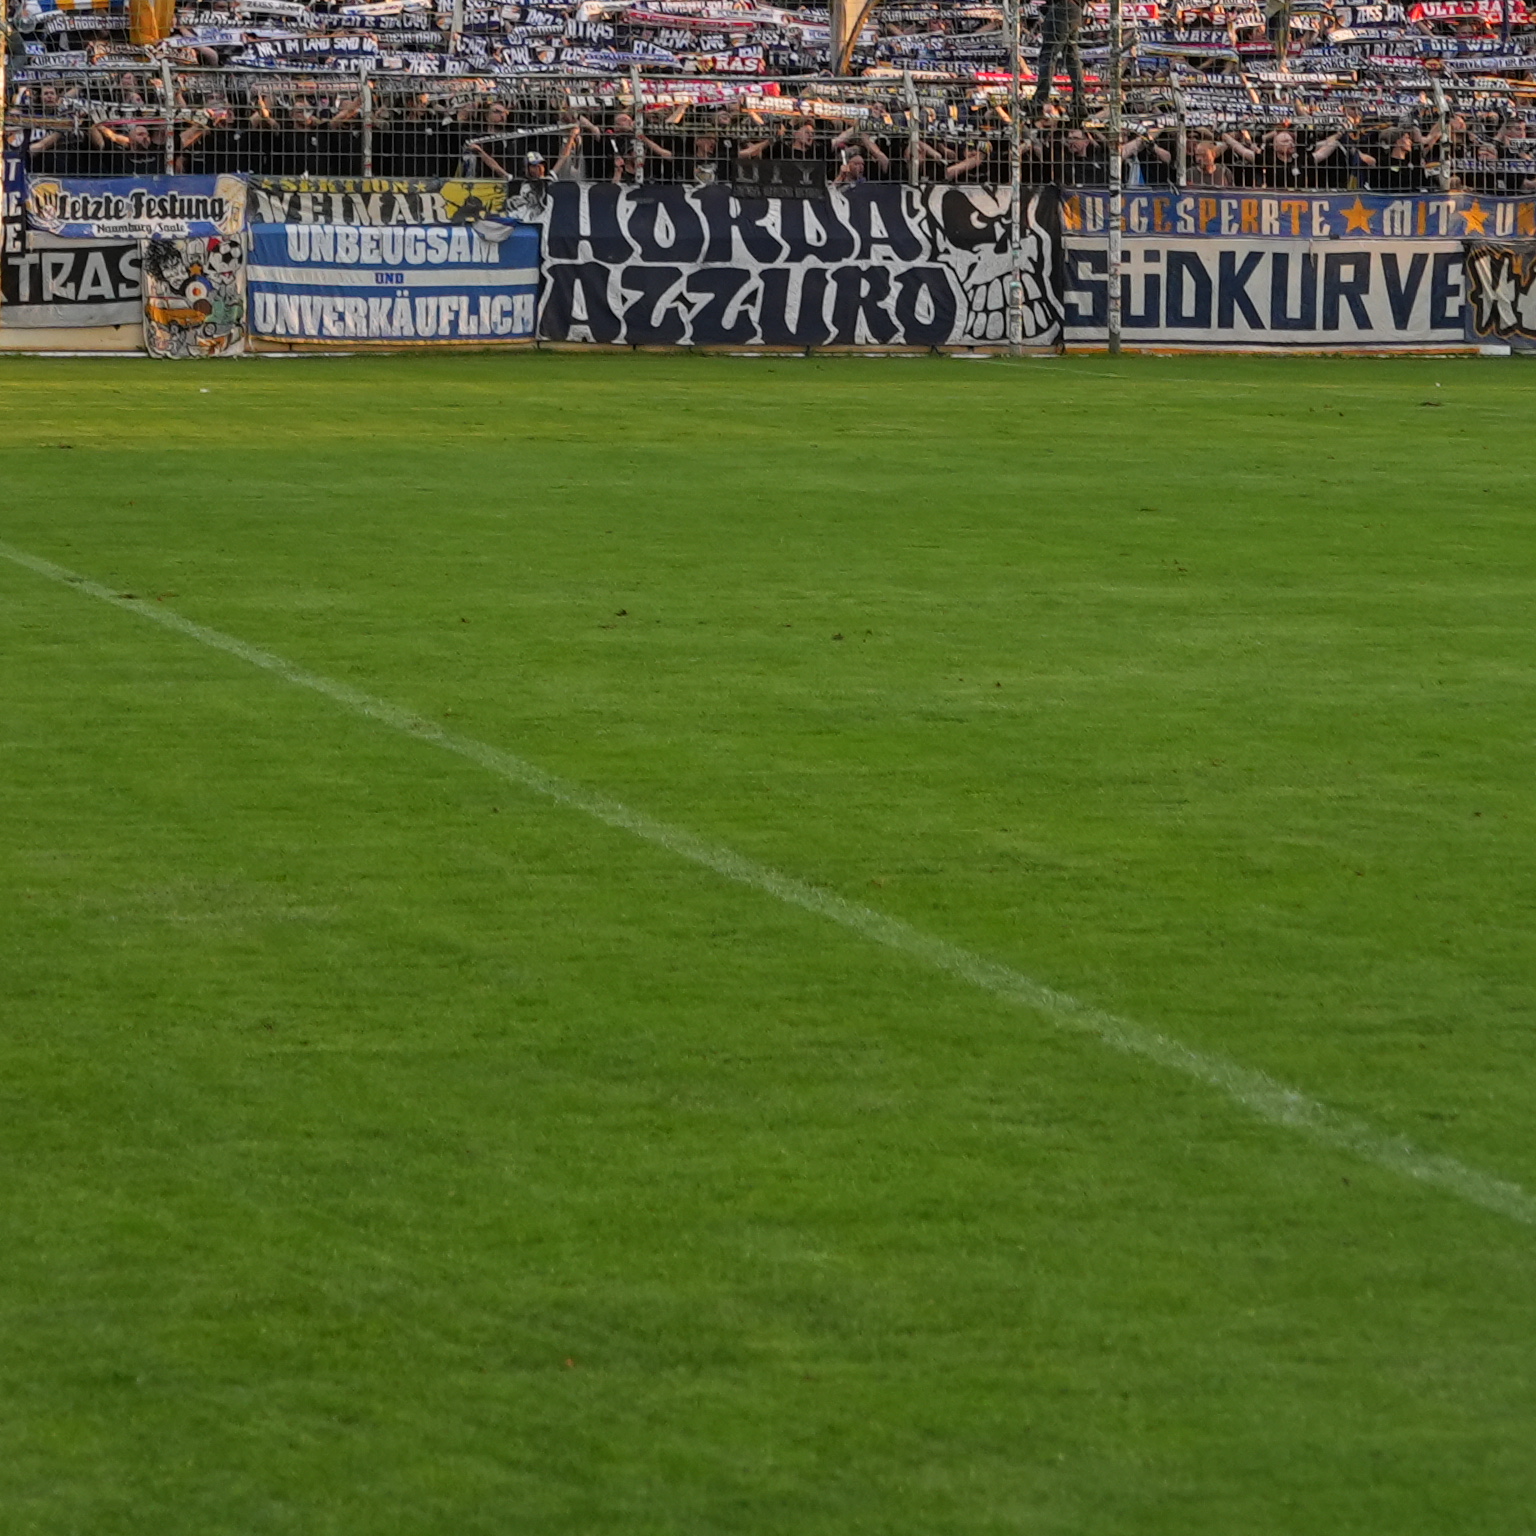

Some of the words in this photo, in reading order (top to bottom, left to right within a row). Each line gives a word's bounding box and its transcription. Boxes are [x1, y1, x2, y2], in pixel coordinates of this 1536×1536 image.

[302, 38, 331, 53] LAND
[58, 190, 126, 220] Letzte
[130, 189, 226, 221] Festung
[278, 177, 410, 194] SEKTION
[254, 189, 453, 227] WEIMAR
[544, 182, 934, 265] HORDA
[1382, 198, 1456, 237] MIT
[284, 223, 501, 265] UNBEUGSAM
[374, 272, 405, 285] UND
[1066, 249, 1465, 331] SÜDKURVE
[252, 289, 536, 339] UNVERKÄUFLICH
[536, 263, 960, 347] AZZURO
